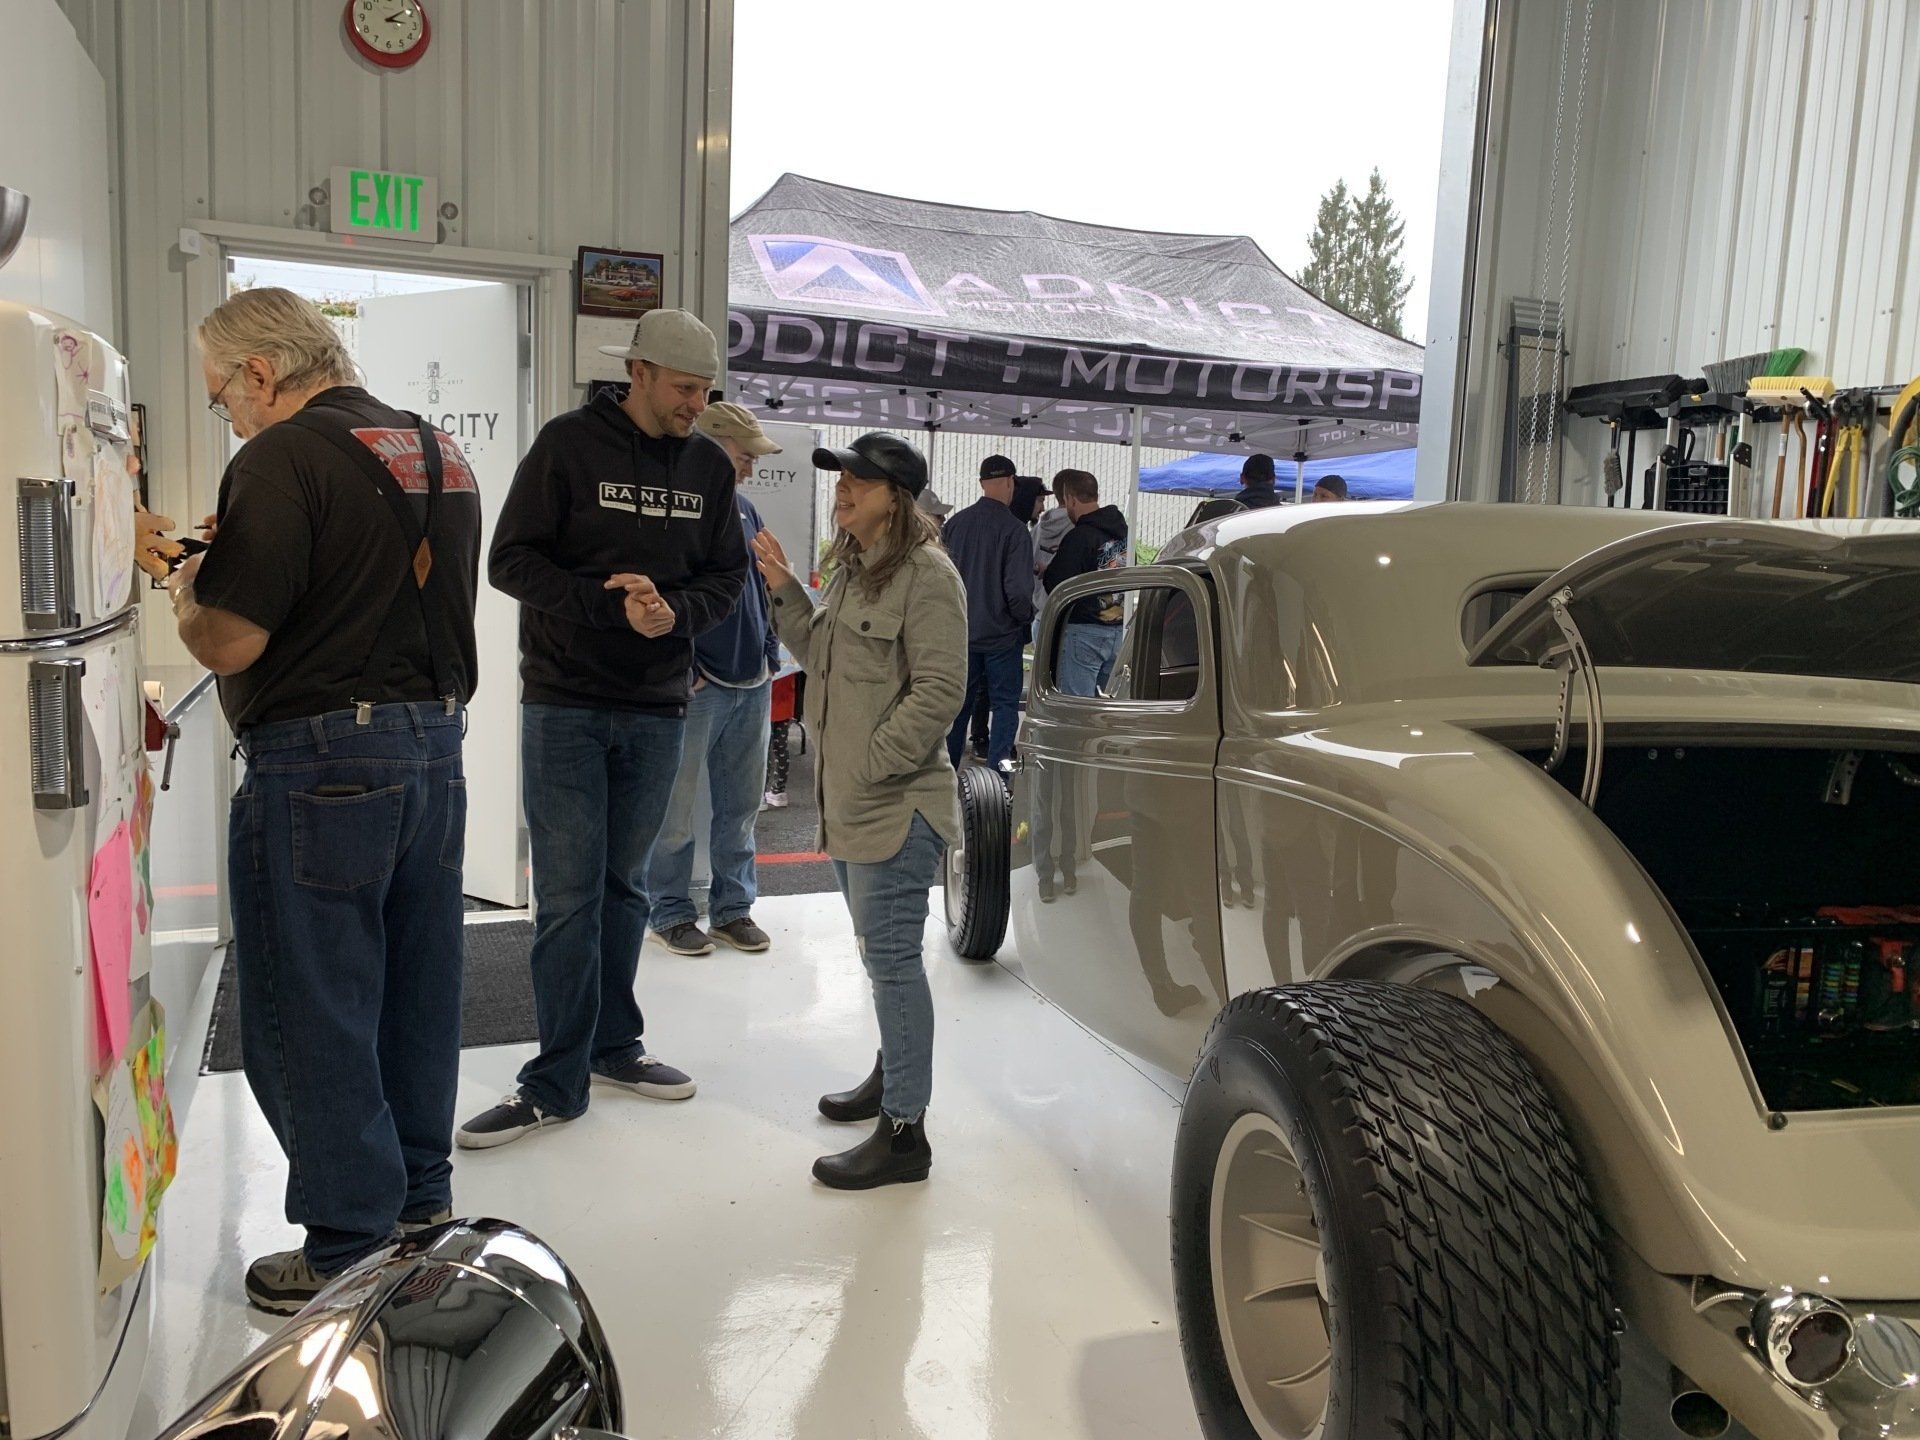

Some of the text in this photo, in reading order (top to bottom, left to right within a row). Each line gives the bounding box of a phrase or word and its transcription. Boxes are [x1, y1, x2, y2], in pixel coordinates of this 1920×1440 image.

[363, 1, 373, 11] 10
[359, 13, 366, 22] 9
[363, 25, 370, 33] 8
[412, 22, 417, 31] 3
[386, 41, 392, 49] 6
[399, 39, 404, 47] 5
[350, 170, 424, 232] EXIT
[937, 272, 1342, 332] ADDICT
[1060, 347, 1422, 410] MOTORSP
[441, 413, 499, 440] CITY
[759, 469, 797, 483] CITY
[748, 480, 779, 488] RAGE
[604, 485, 699, 509] RAN CITY
